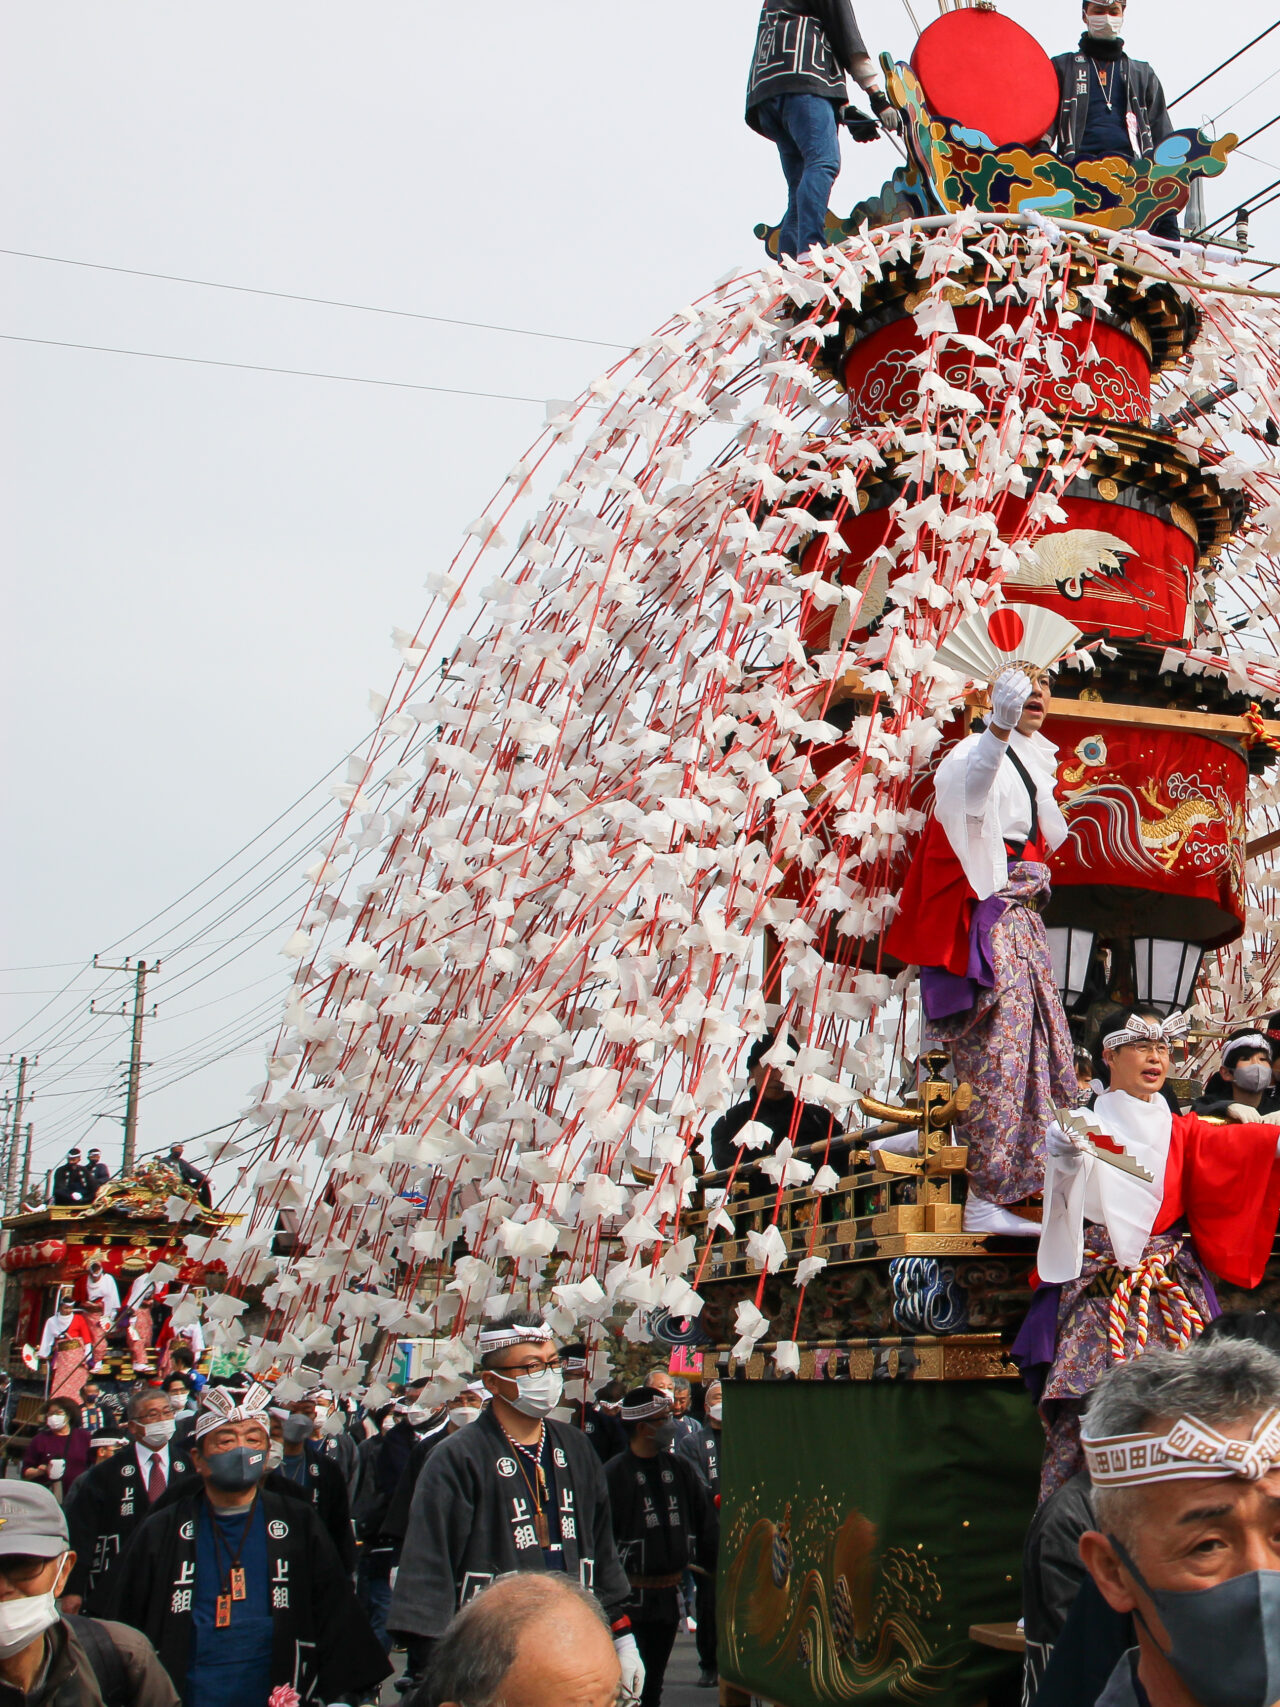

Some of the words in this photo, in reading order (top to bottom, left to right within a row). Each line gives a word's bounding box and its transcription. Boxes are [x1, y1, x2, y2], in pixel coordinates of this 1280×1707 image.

[510, 1497, 538, 1550] 上組
[560, 1488, 577, 1540] 上組
[171, 1560, 195, 1613] 上組
[271, 1558, 289, 1608] 上組
